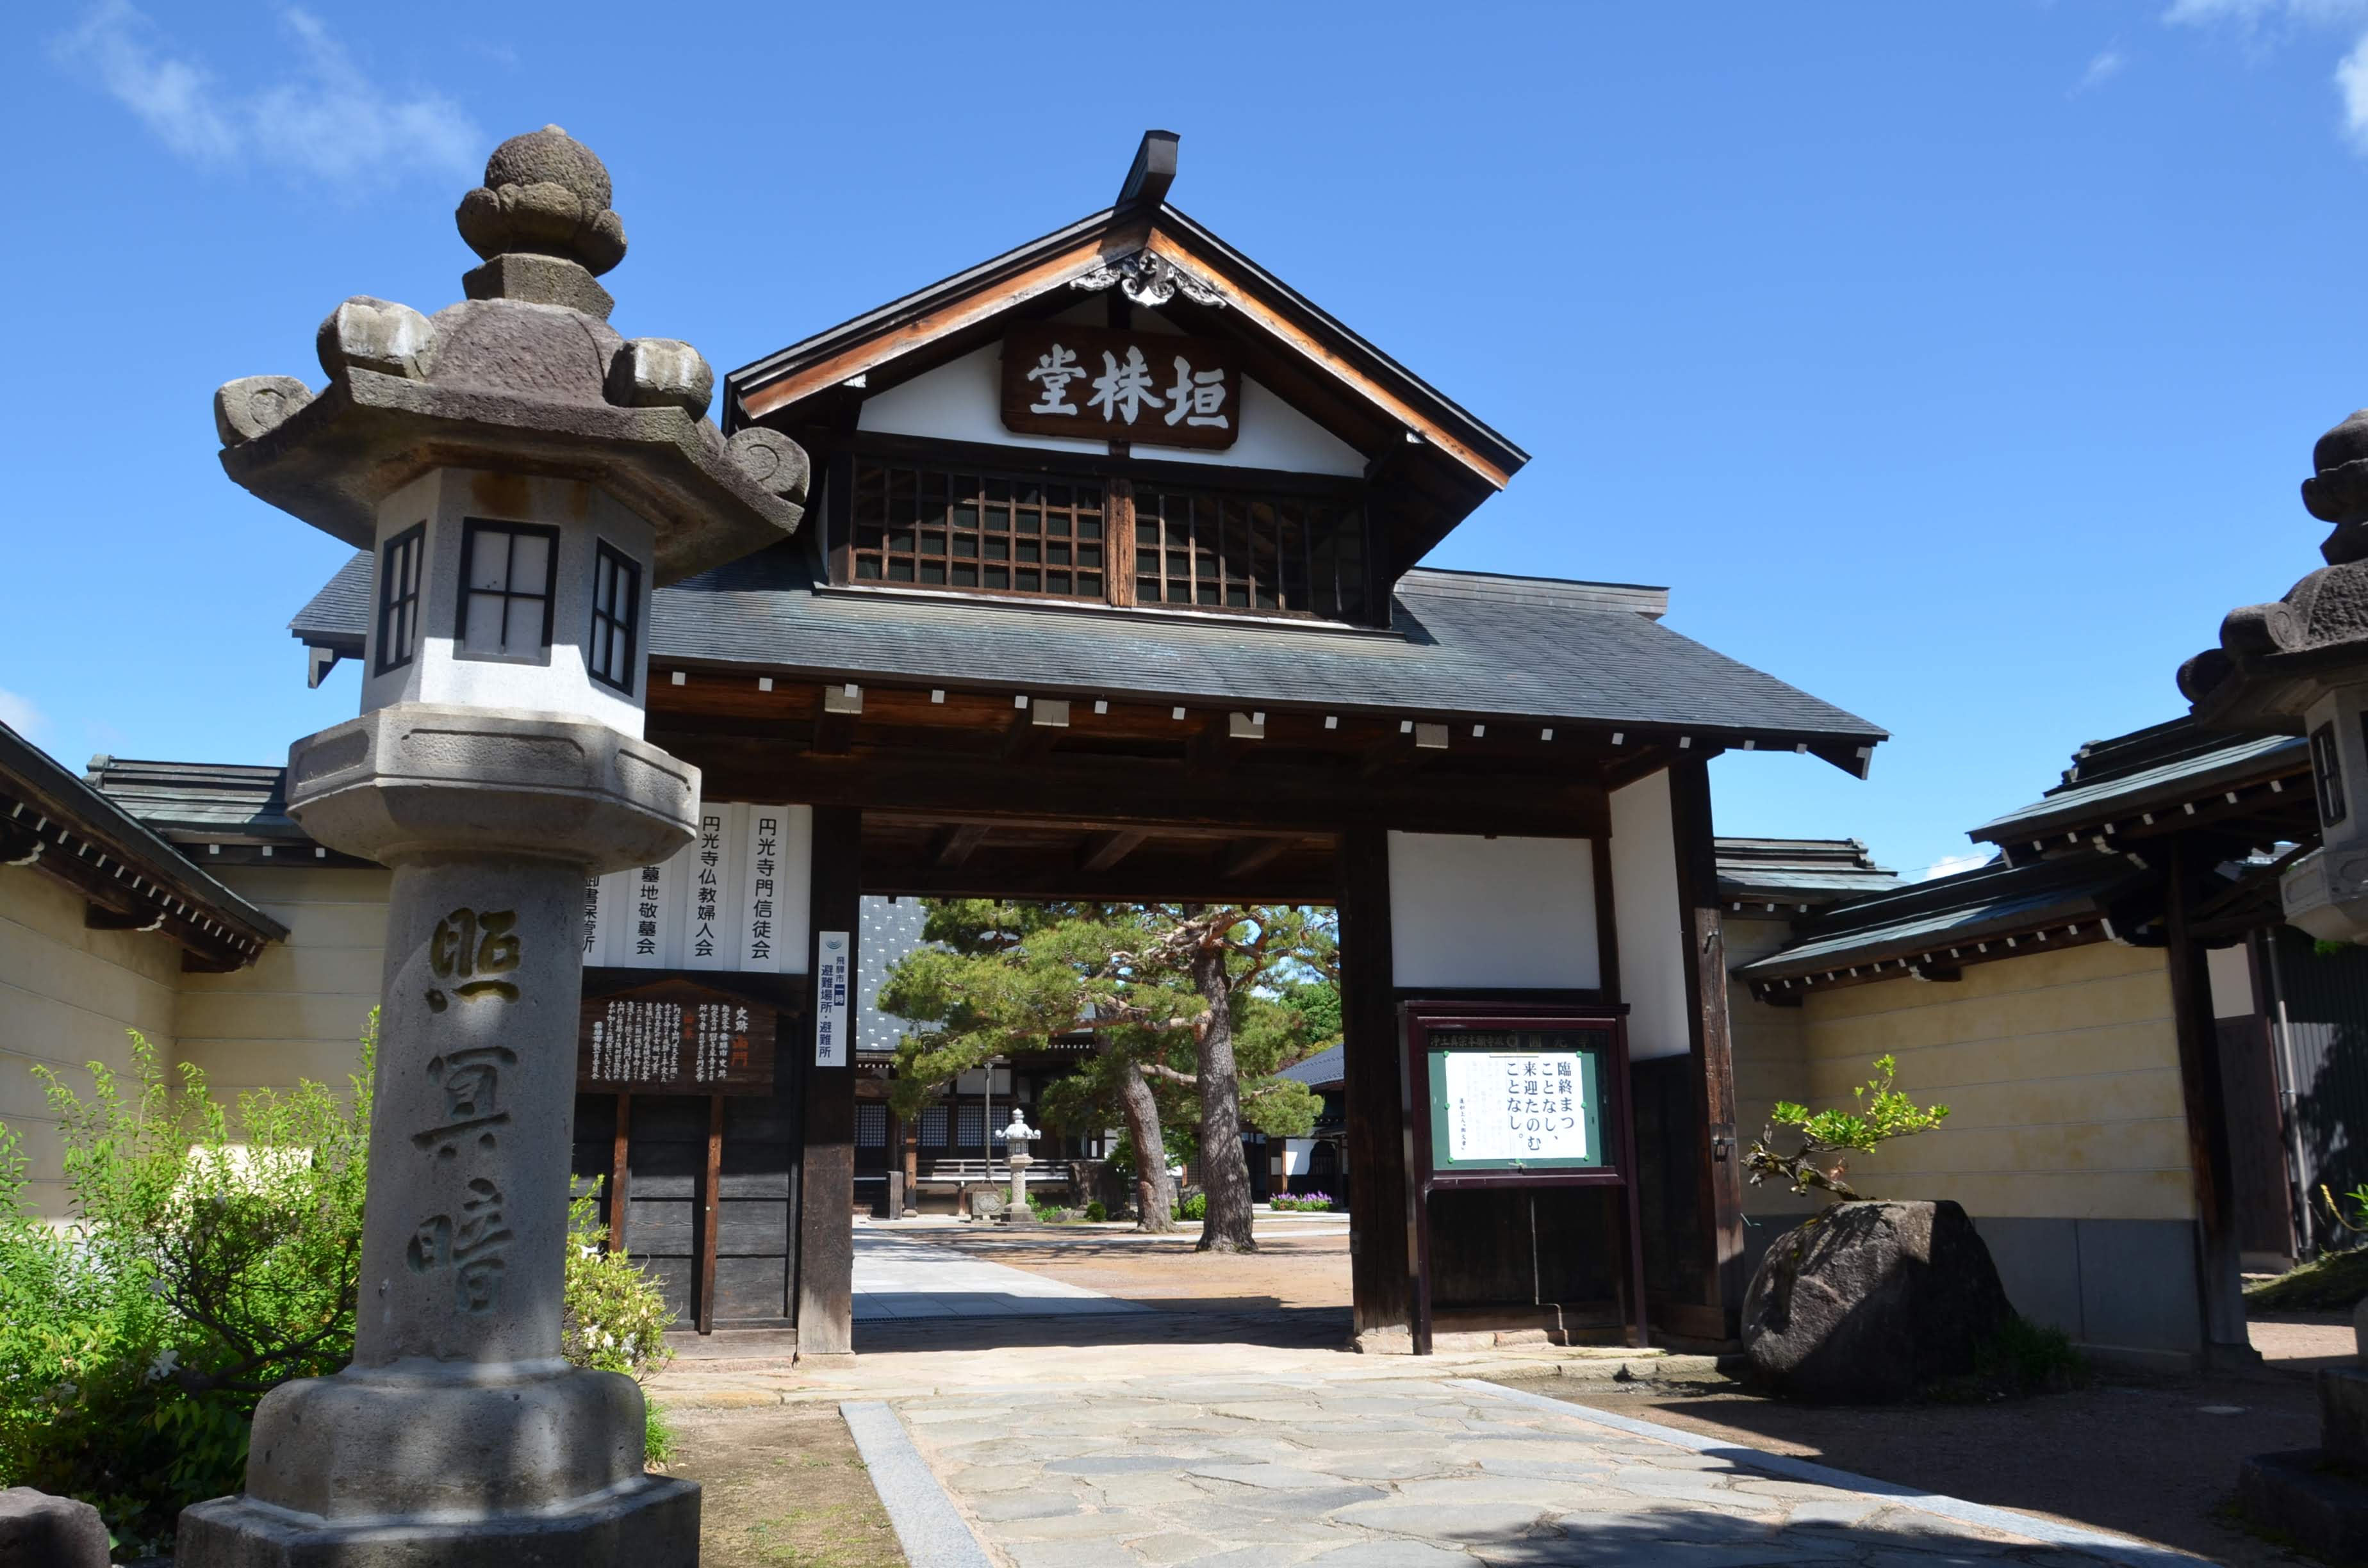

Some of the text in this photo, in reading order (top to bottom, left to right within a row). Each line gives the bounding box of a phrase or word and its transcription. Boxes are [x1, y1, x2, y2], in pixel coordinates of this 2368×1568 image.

[695, 816, 721, 958] 円光寺仏教婦人会
[752, 818, 777, 960] 円光寺門信徒会
[1507, 1062, 1524, 1139] ことなし。
[1523, 1061, 1542, 1151] 来迎たのむ
[1558, 1061, 1574, 1129] 臨終まつ
